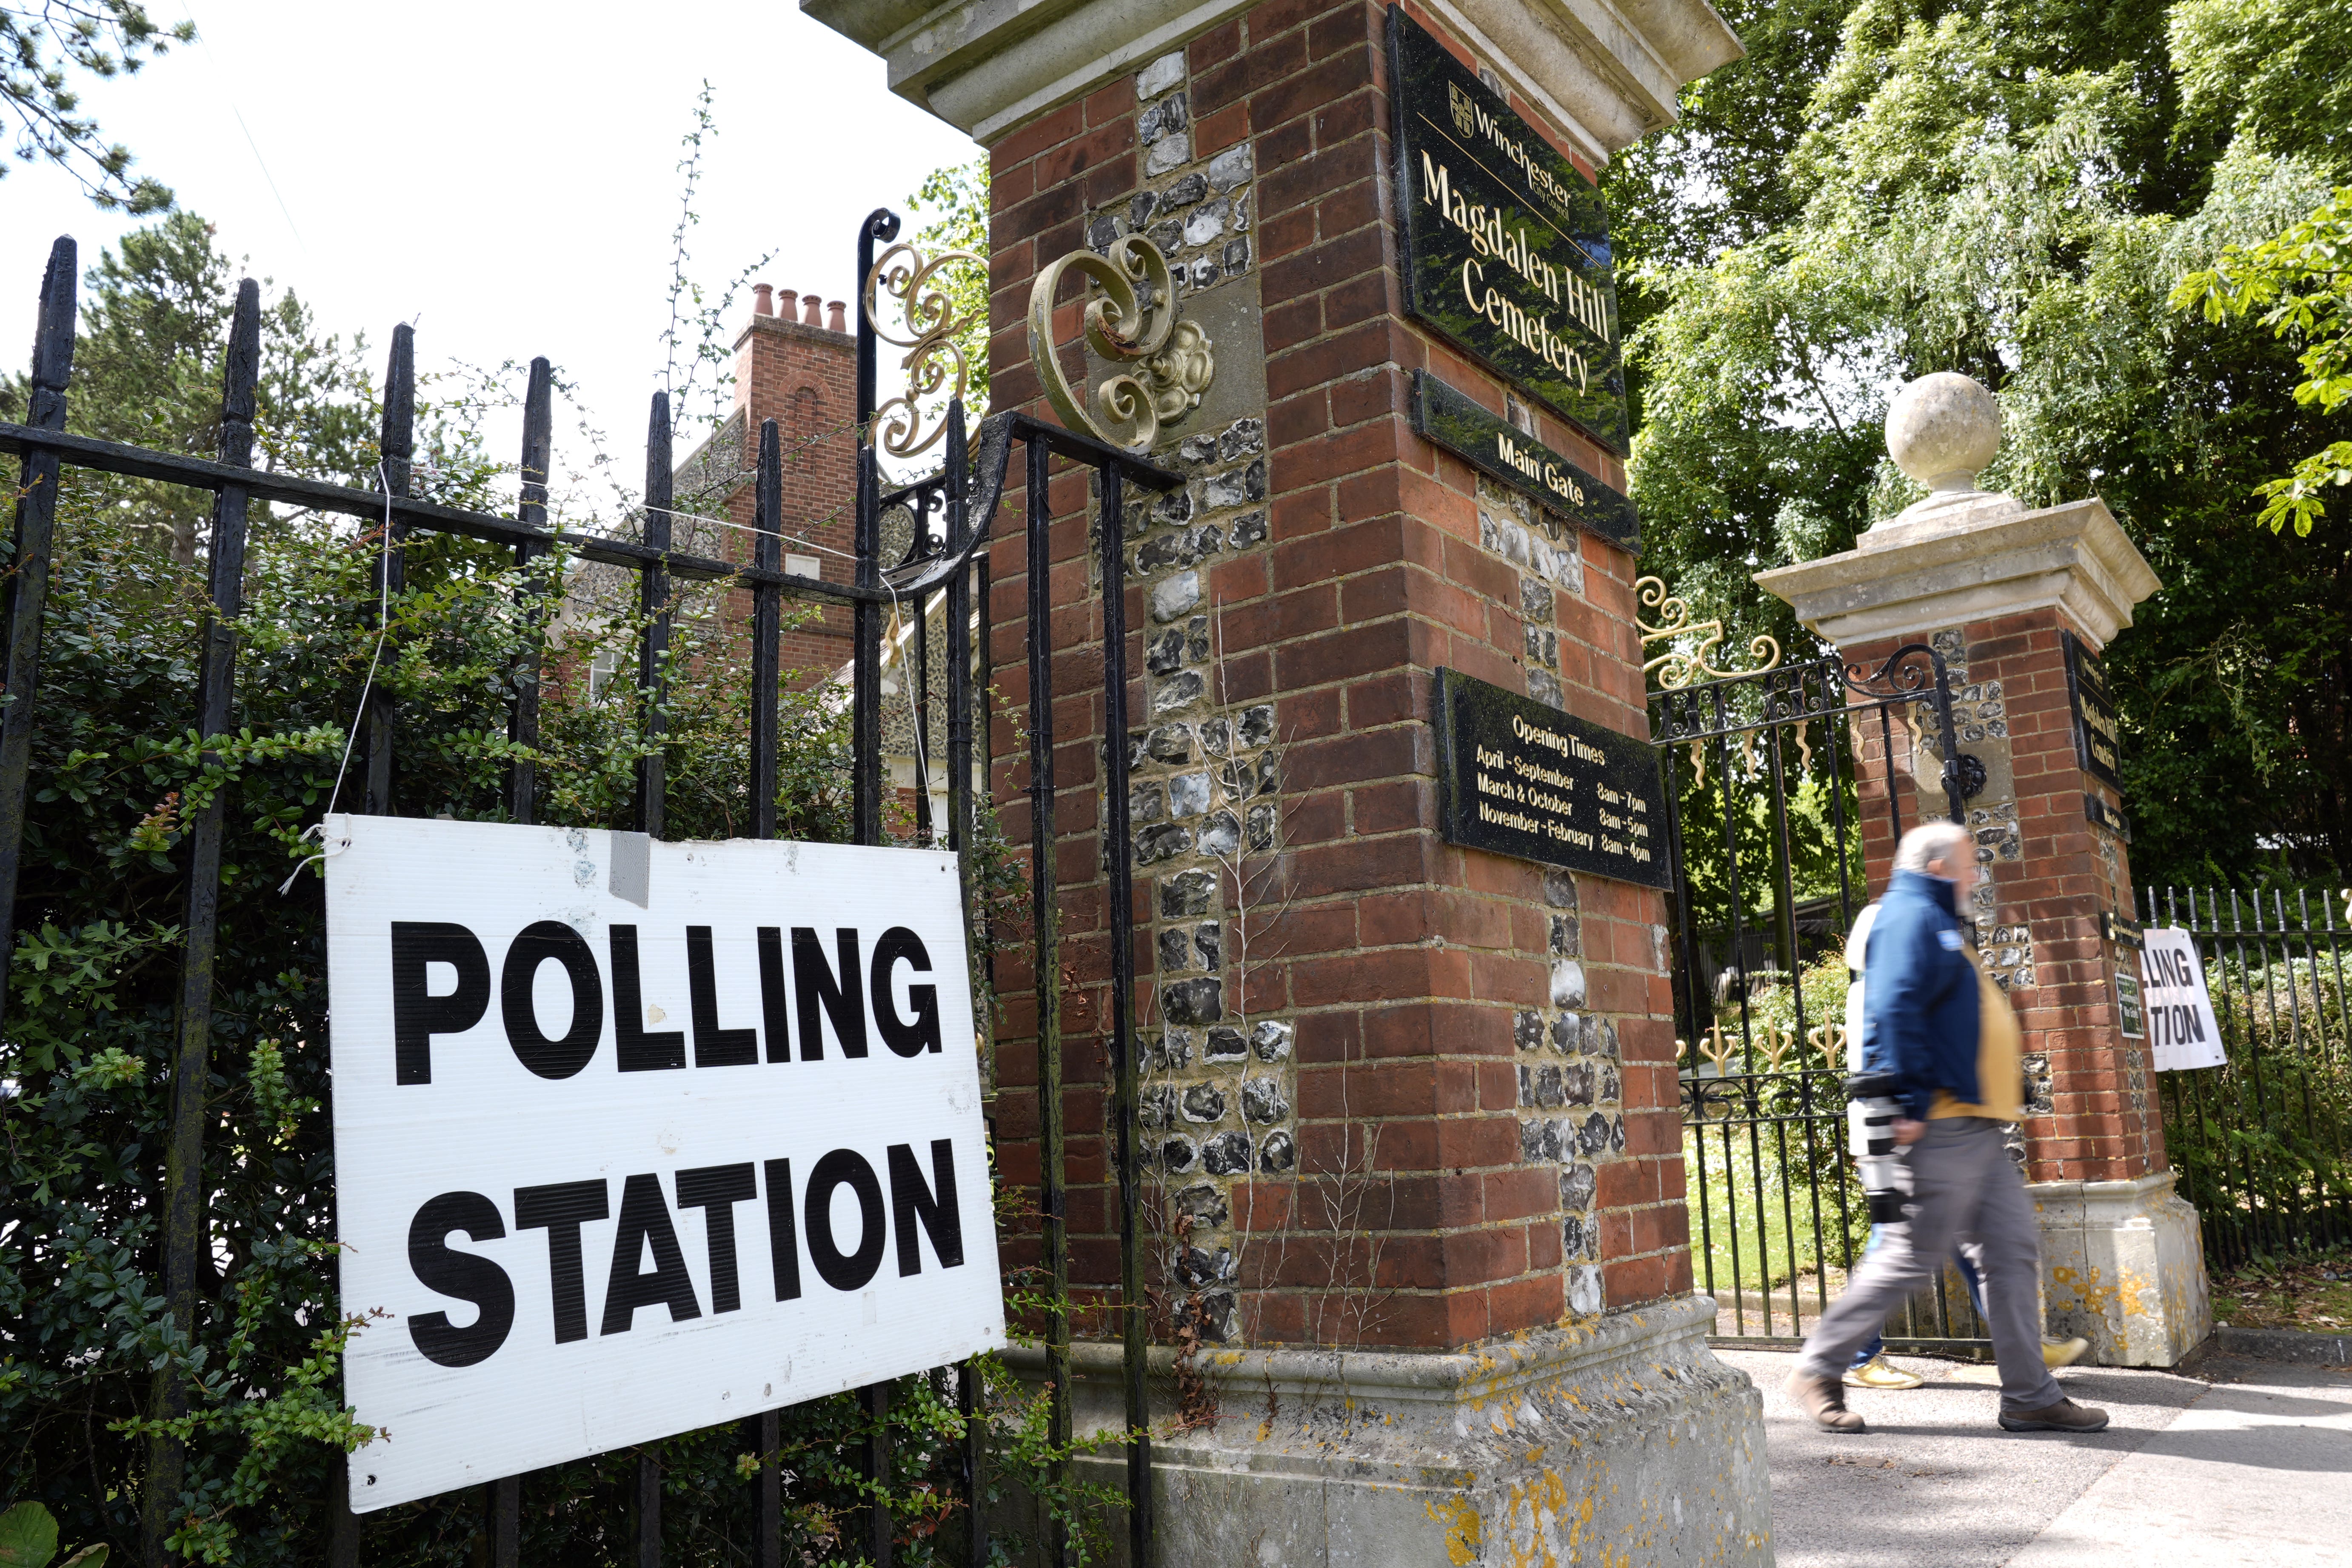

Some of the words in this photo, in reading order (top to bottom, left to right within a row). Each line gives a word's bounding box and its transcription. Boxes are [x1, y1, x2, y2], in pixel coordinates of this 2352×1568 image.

[1474, 103, 1571, 207] Winchester
[1532, 181, 1546, 203] City
[1547, 195, 1569, 221] Council
[1421, 149, 1560, 305] Magdalen
[1564, 265, 1610, 344] Hill
[1463, 257, 1587, 397] Cemetery
[1498, 432, 1540, 482] Main
[1545, 462, 1584, 507] Gate
[1513, 714, 1569, 758] Opening
[1568, 734, 1605, 766] Times
[1476, 744, 1504, 769] April
[1514, 755, 1574, 790] September
[1597, 782, 1619, 804] 8am
[1626, 791, 1646, 813] 7pm
[1477, 771, 1515, 800] March
[1517, 783, 1526, 803] &
[1528, 787, 1572, 816] October
[1599, 808, 1621, 830] 8am
[1627, 816, 1648, 837] 5pm
[1479, 800, 1539, 834] November
[1547, 819, 1593, 851] February
[1601, 833, 1623, 855] 8am
[1630, 841, 1650, 863] 4pm
[391, 920, 943, 1086] POLLING
[407, 1138, 964, 1368] STATION
